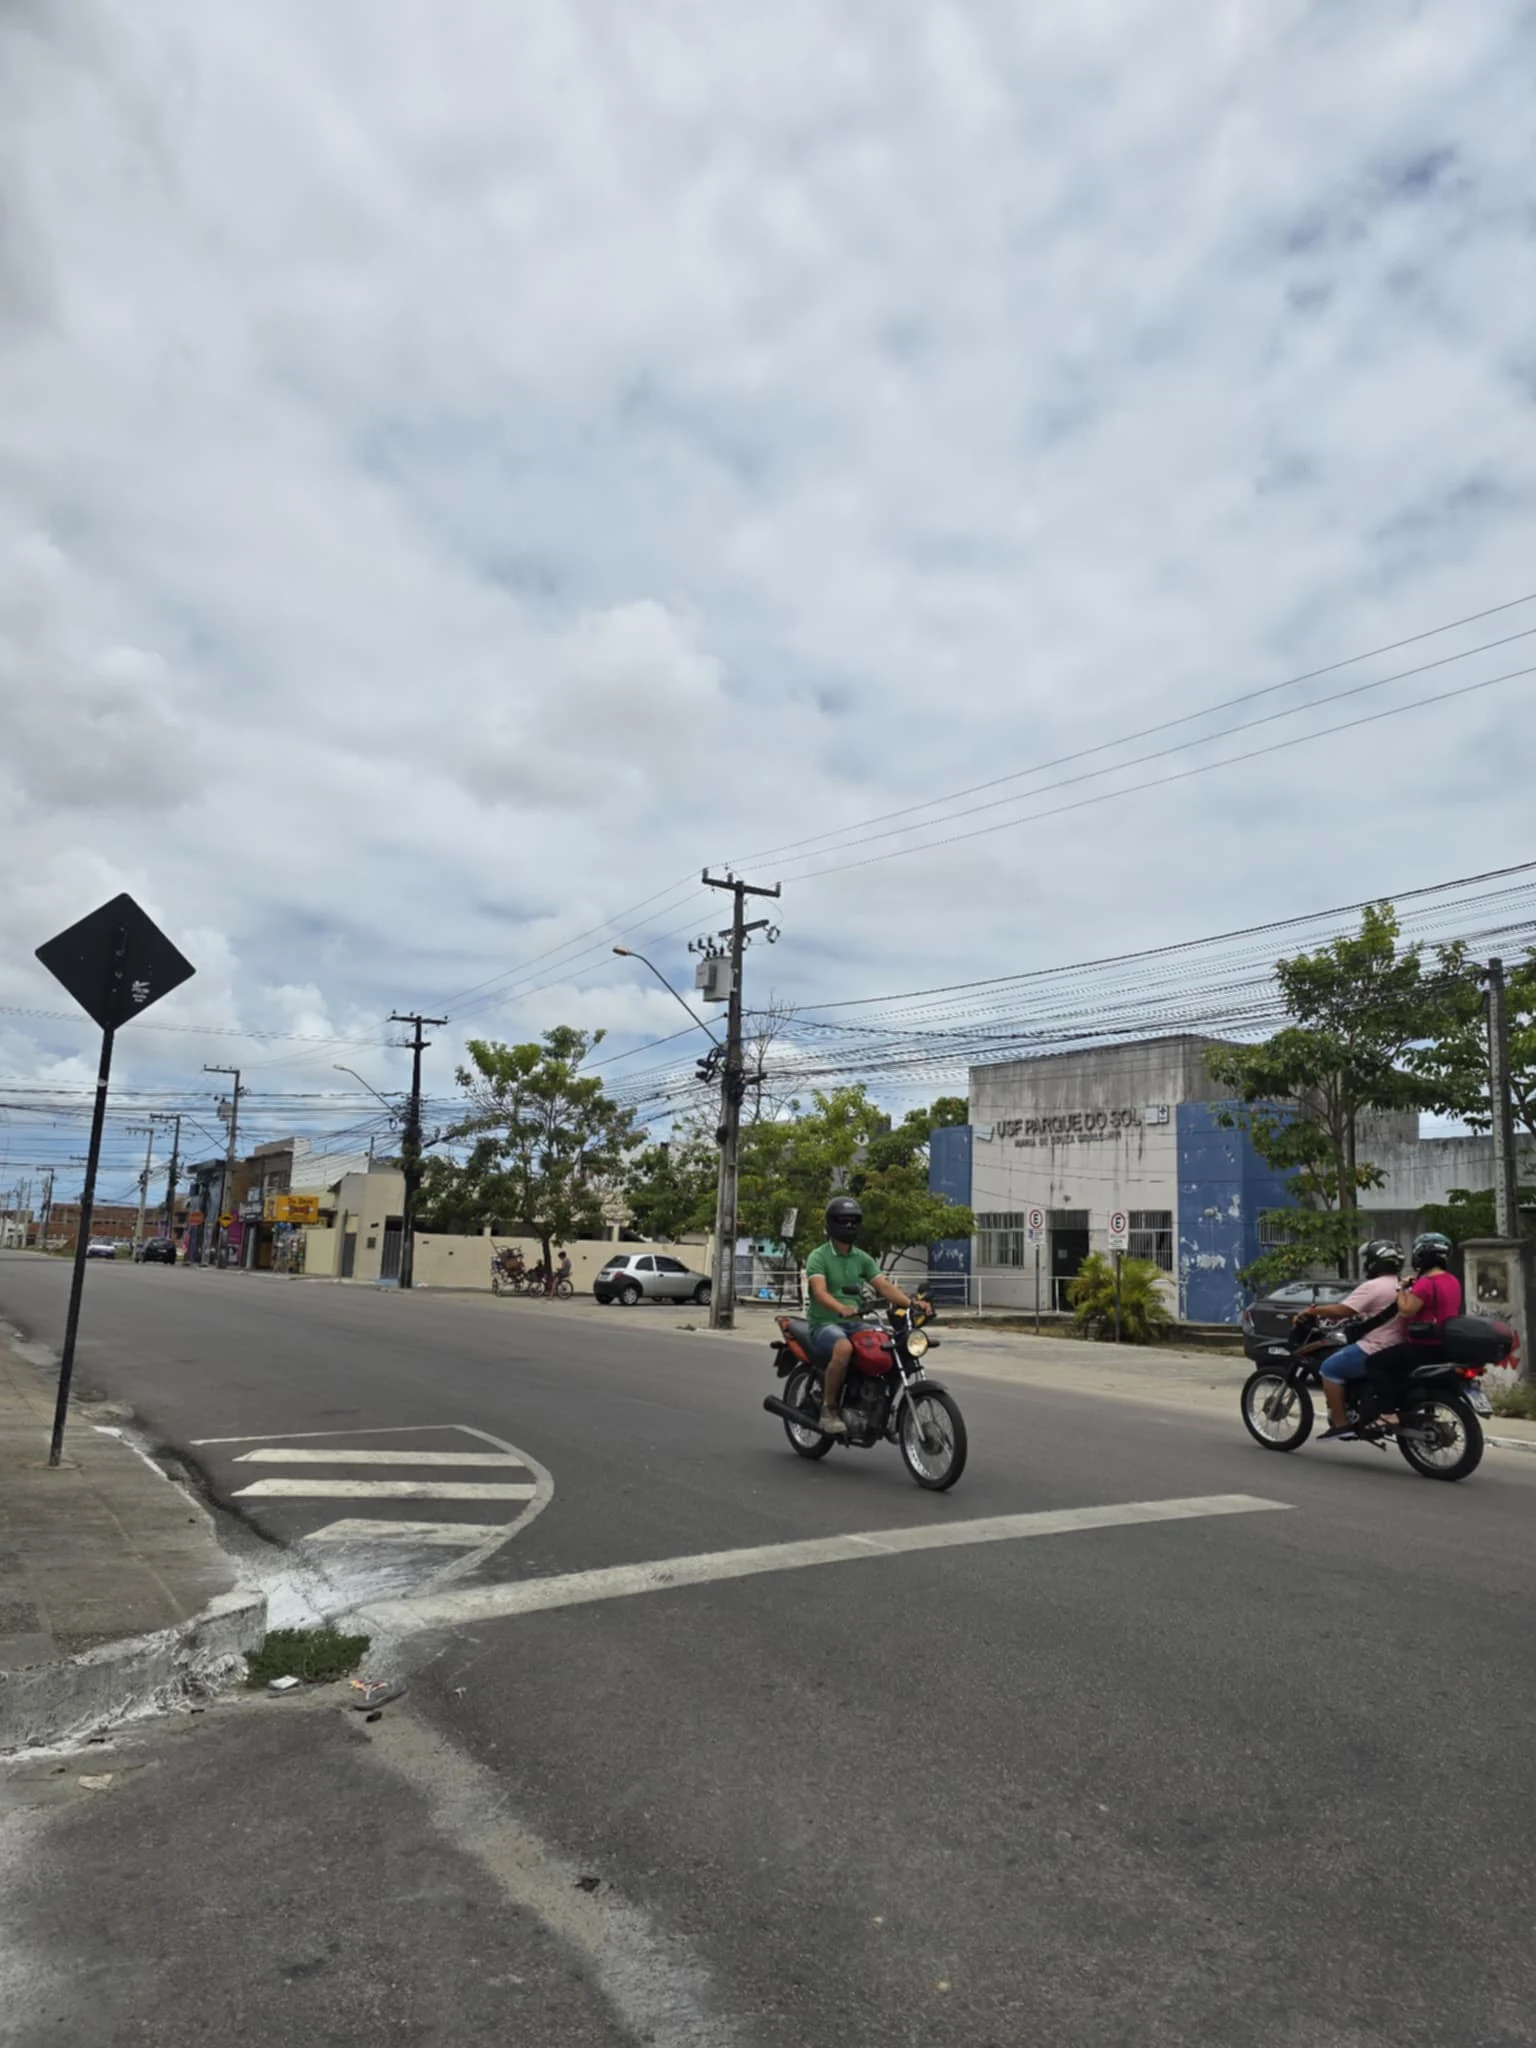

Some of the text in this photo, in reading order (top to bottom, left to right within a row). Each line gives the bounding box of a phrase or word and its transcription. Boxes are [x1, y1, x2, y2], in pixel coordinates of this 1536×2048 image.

[997, 1107, 1142, 1138] USF PARQUE DO SOL
[1032, 1213, 1040, 1225] E
[1115, 1216, 1121, 1229] E
